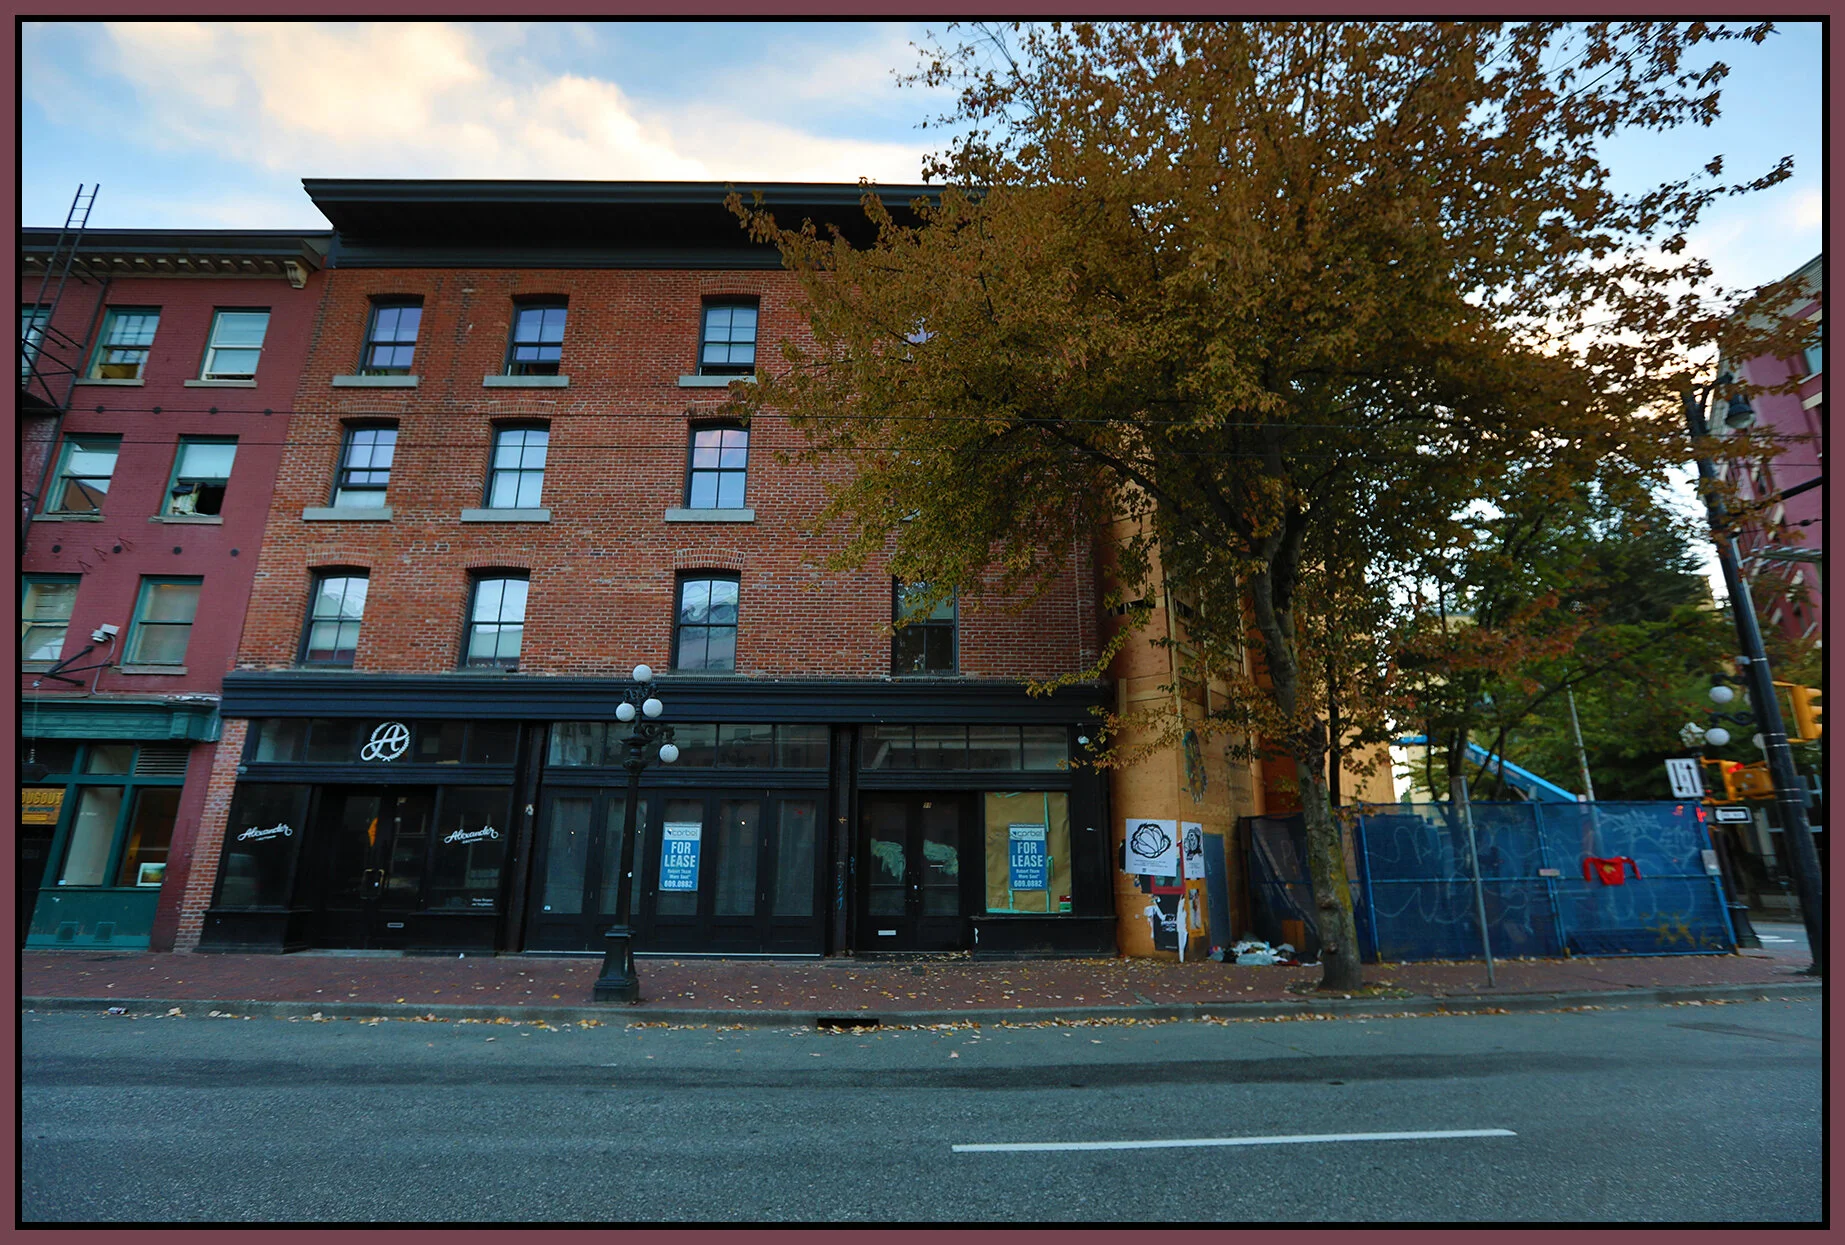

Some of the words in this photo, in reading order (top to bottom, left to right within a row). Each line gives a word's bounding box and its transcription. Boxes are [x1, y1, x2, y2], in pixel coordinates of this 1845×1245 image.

[237, 823, 293, 841] Alexander
[443, 825, 499, 844] Alexander
[671, 841, 692, 855] FOR
[1017, 841, 1038, 855] FOR
[664, 854, 696, 868] LEASE
[1011, 854, 1044, 868] LEASE
